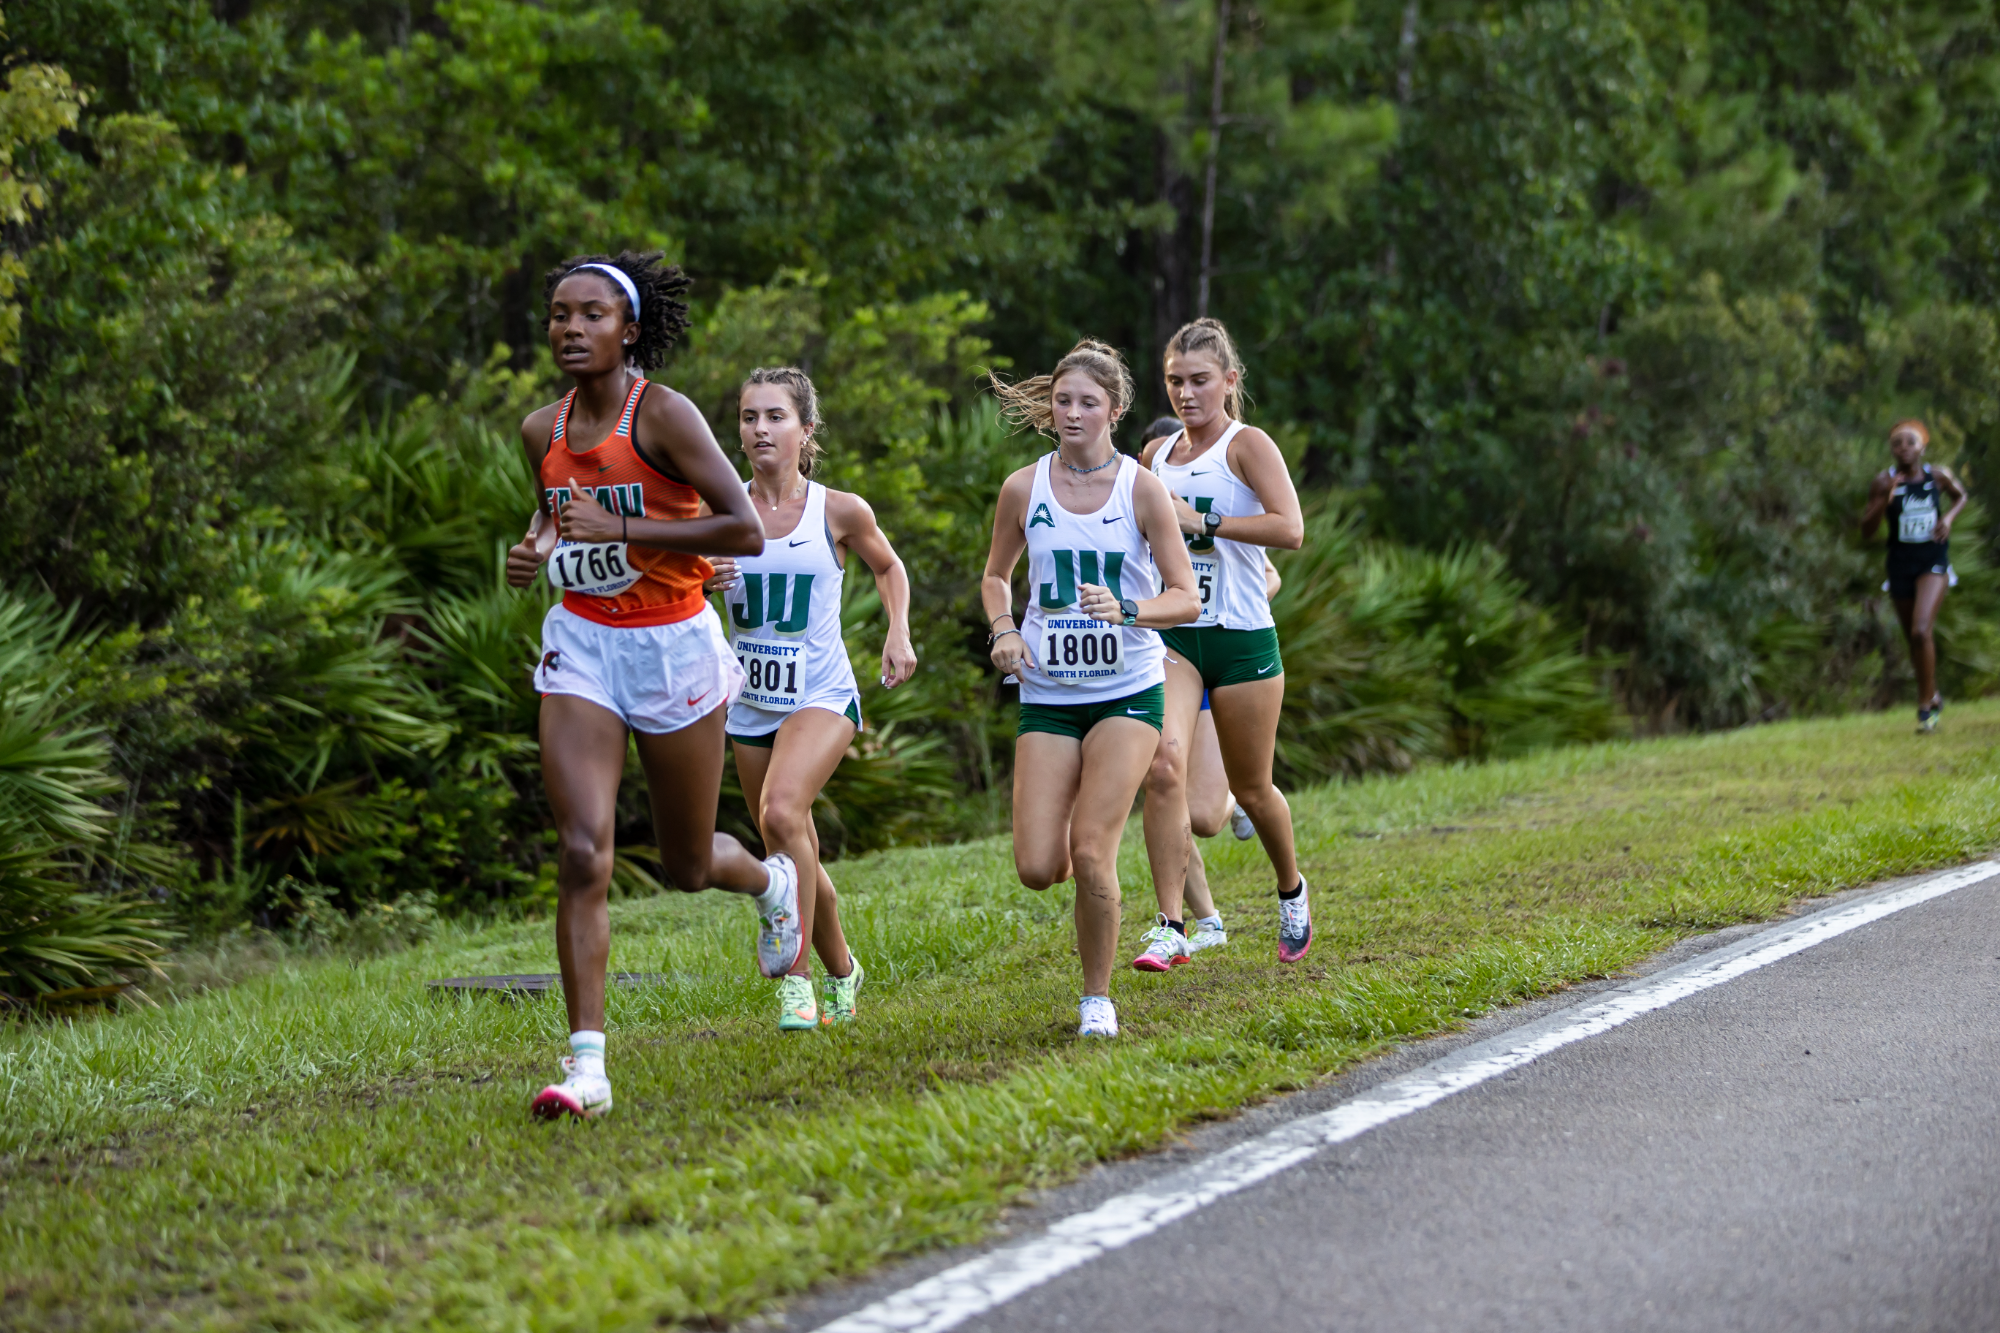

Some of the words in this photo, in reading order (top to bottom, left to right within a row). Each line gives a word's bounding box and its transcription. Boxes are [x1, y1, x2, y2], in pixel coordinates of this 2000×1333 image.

[555, 543, 626, 588] 1766
[597, 577, 635, 594] FLORIDA
[732, 573, 816, 636] JU
[737, 640, 800, 657] UNIVERSITY
[1047, 633, 1118, 666] 1800
[1047, 669, 1077, 679] NORTH
[1079, 668, 1118, 679] FLORIDA
[740, 691, 759, 702] ORTH
[760, 695, 796, 706] FLORIDA
